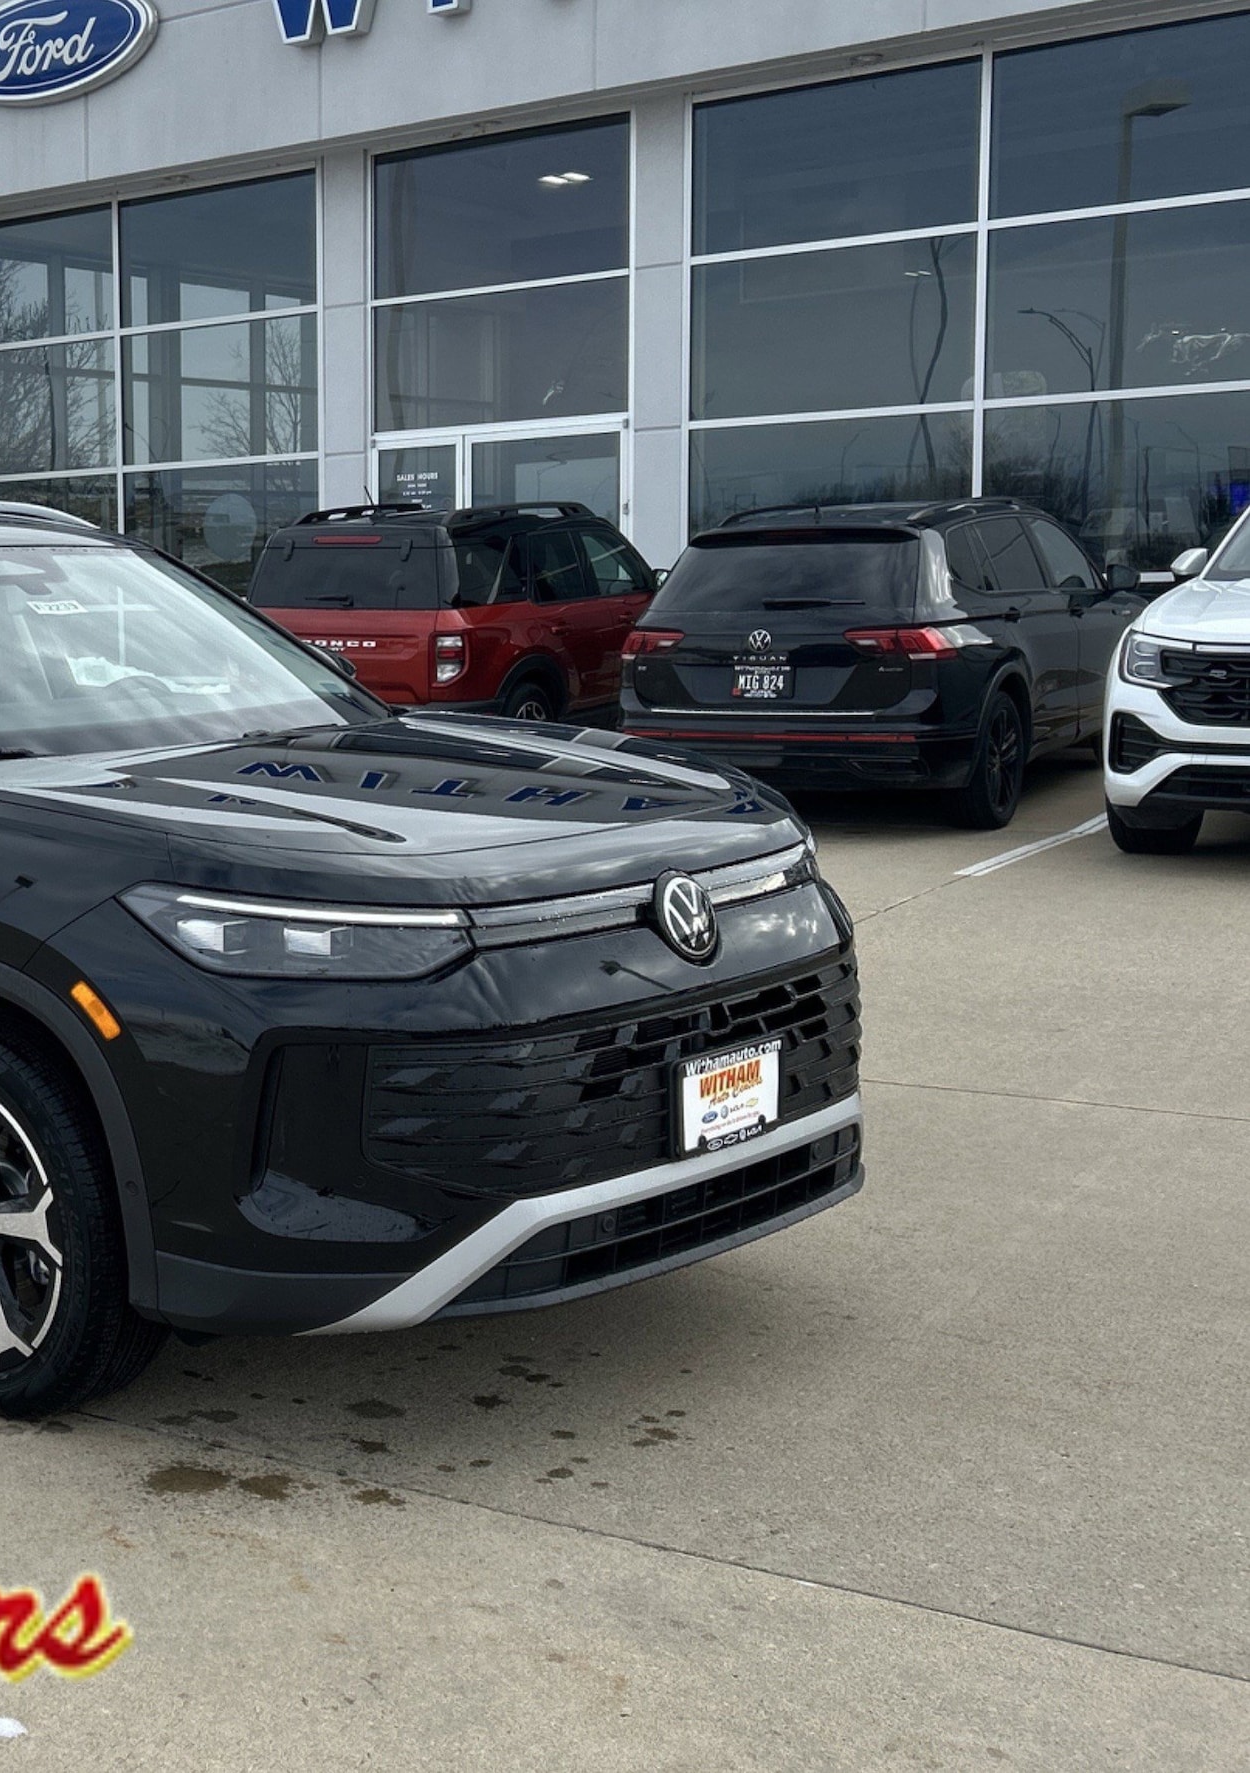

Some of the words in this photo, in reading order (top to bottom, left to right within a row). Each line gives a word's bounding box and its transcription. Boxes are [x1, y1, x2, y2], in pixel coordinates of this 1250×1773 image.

[397, 473, 415, 481] SALES
[417, 472, 438, 480] HOURS
[762, 674, 784, 690] 824
[700, 1059, 761, 1098] WITHAM
